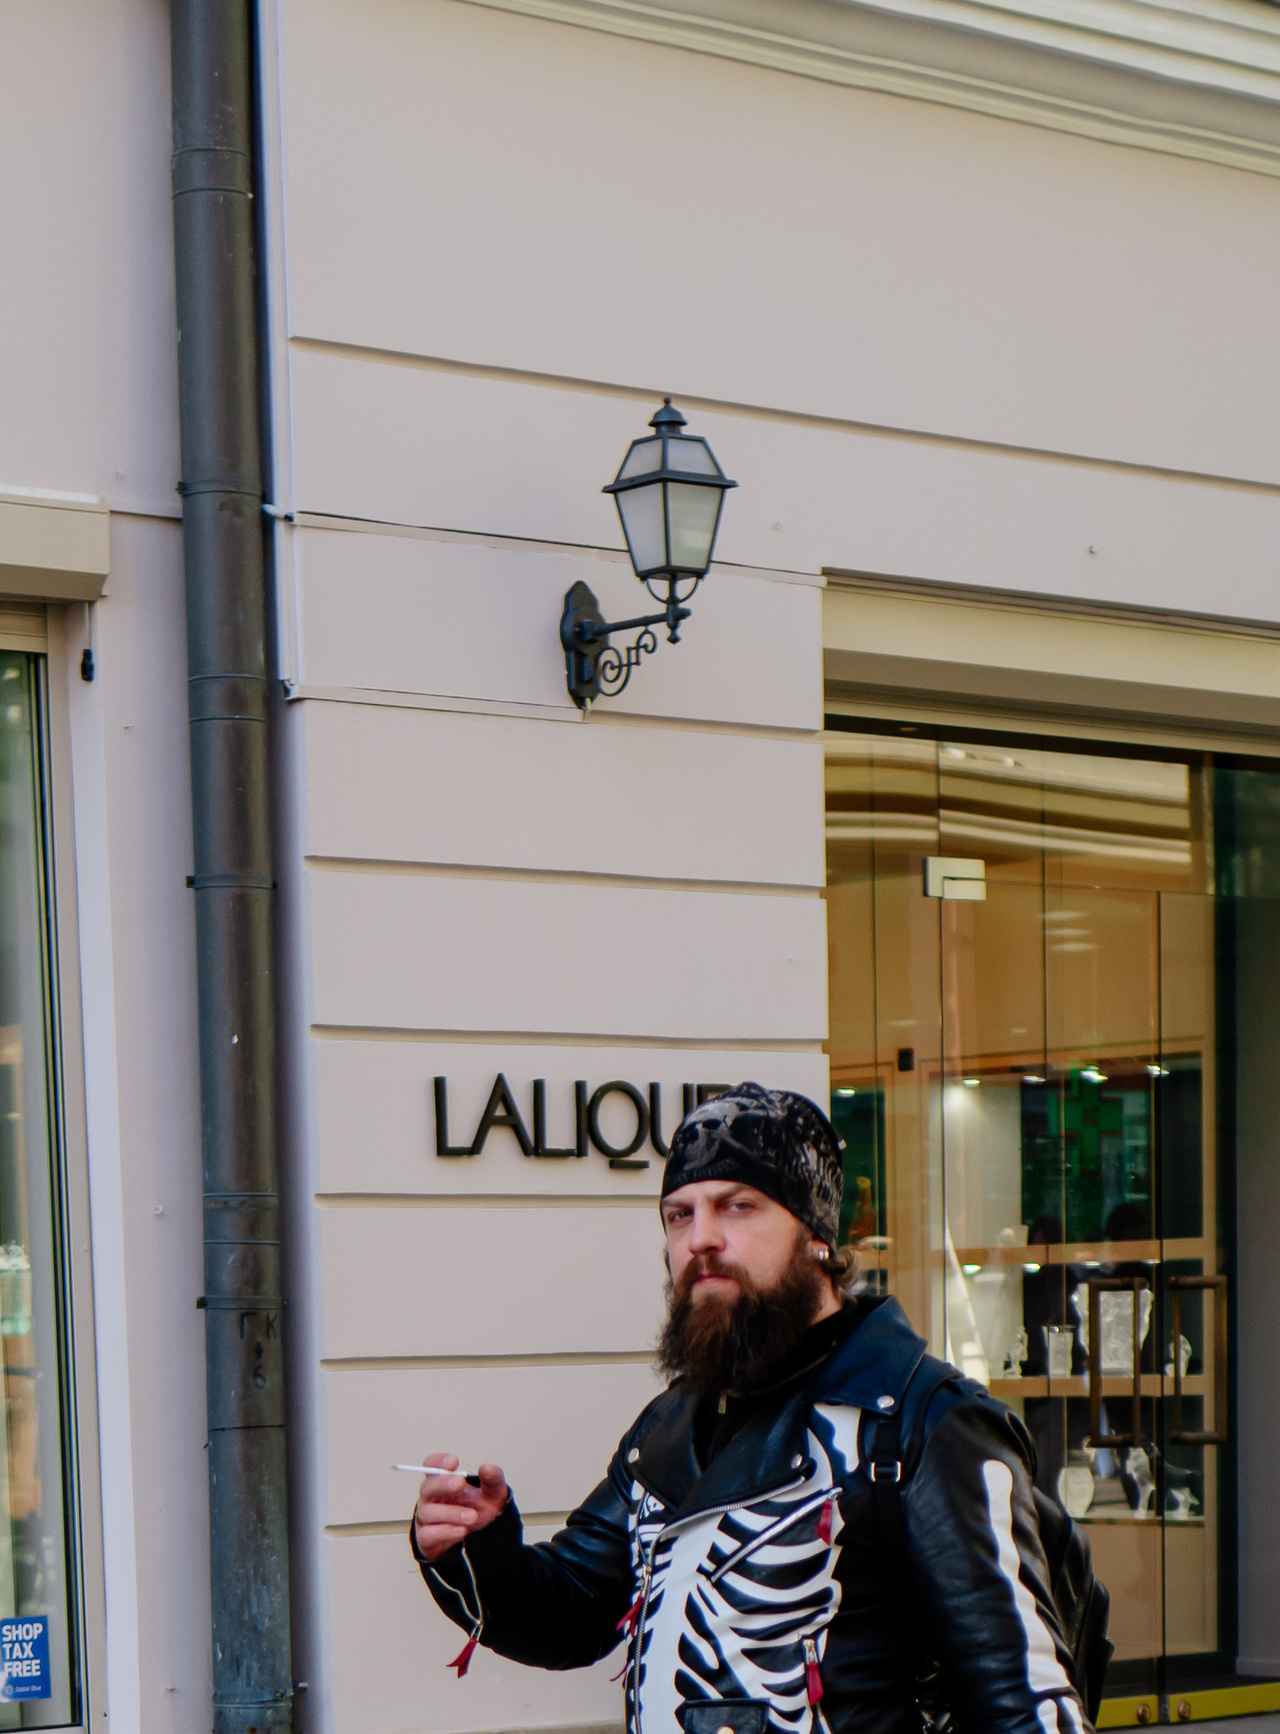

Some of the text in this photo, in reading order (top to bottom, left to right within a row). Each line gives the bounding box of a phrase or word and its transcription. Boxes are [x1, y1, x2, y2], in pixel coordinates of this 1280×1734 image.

[433, 1072, 734, 1168] LALIQU
[2, 1622, 43, 1641] SHOP
[2, 1641, 34, 1660] TAX
[4, 1659, 41, 1677] FREE
